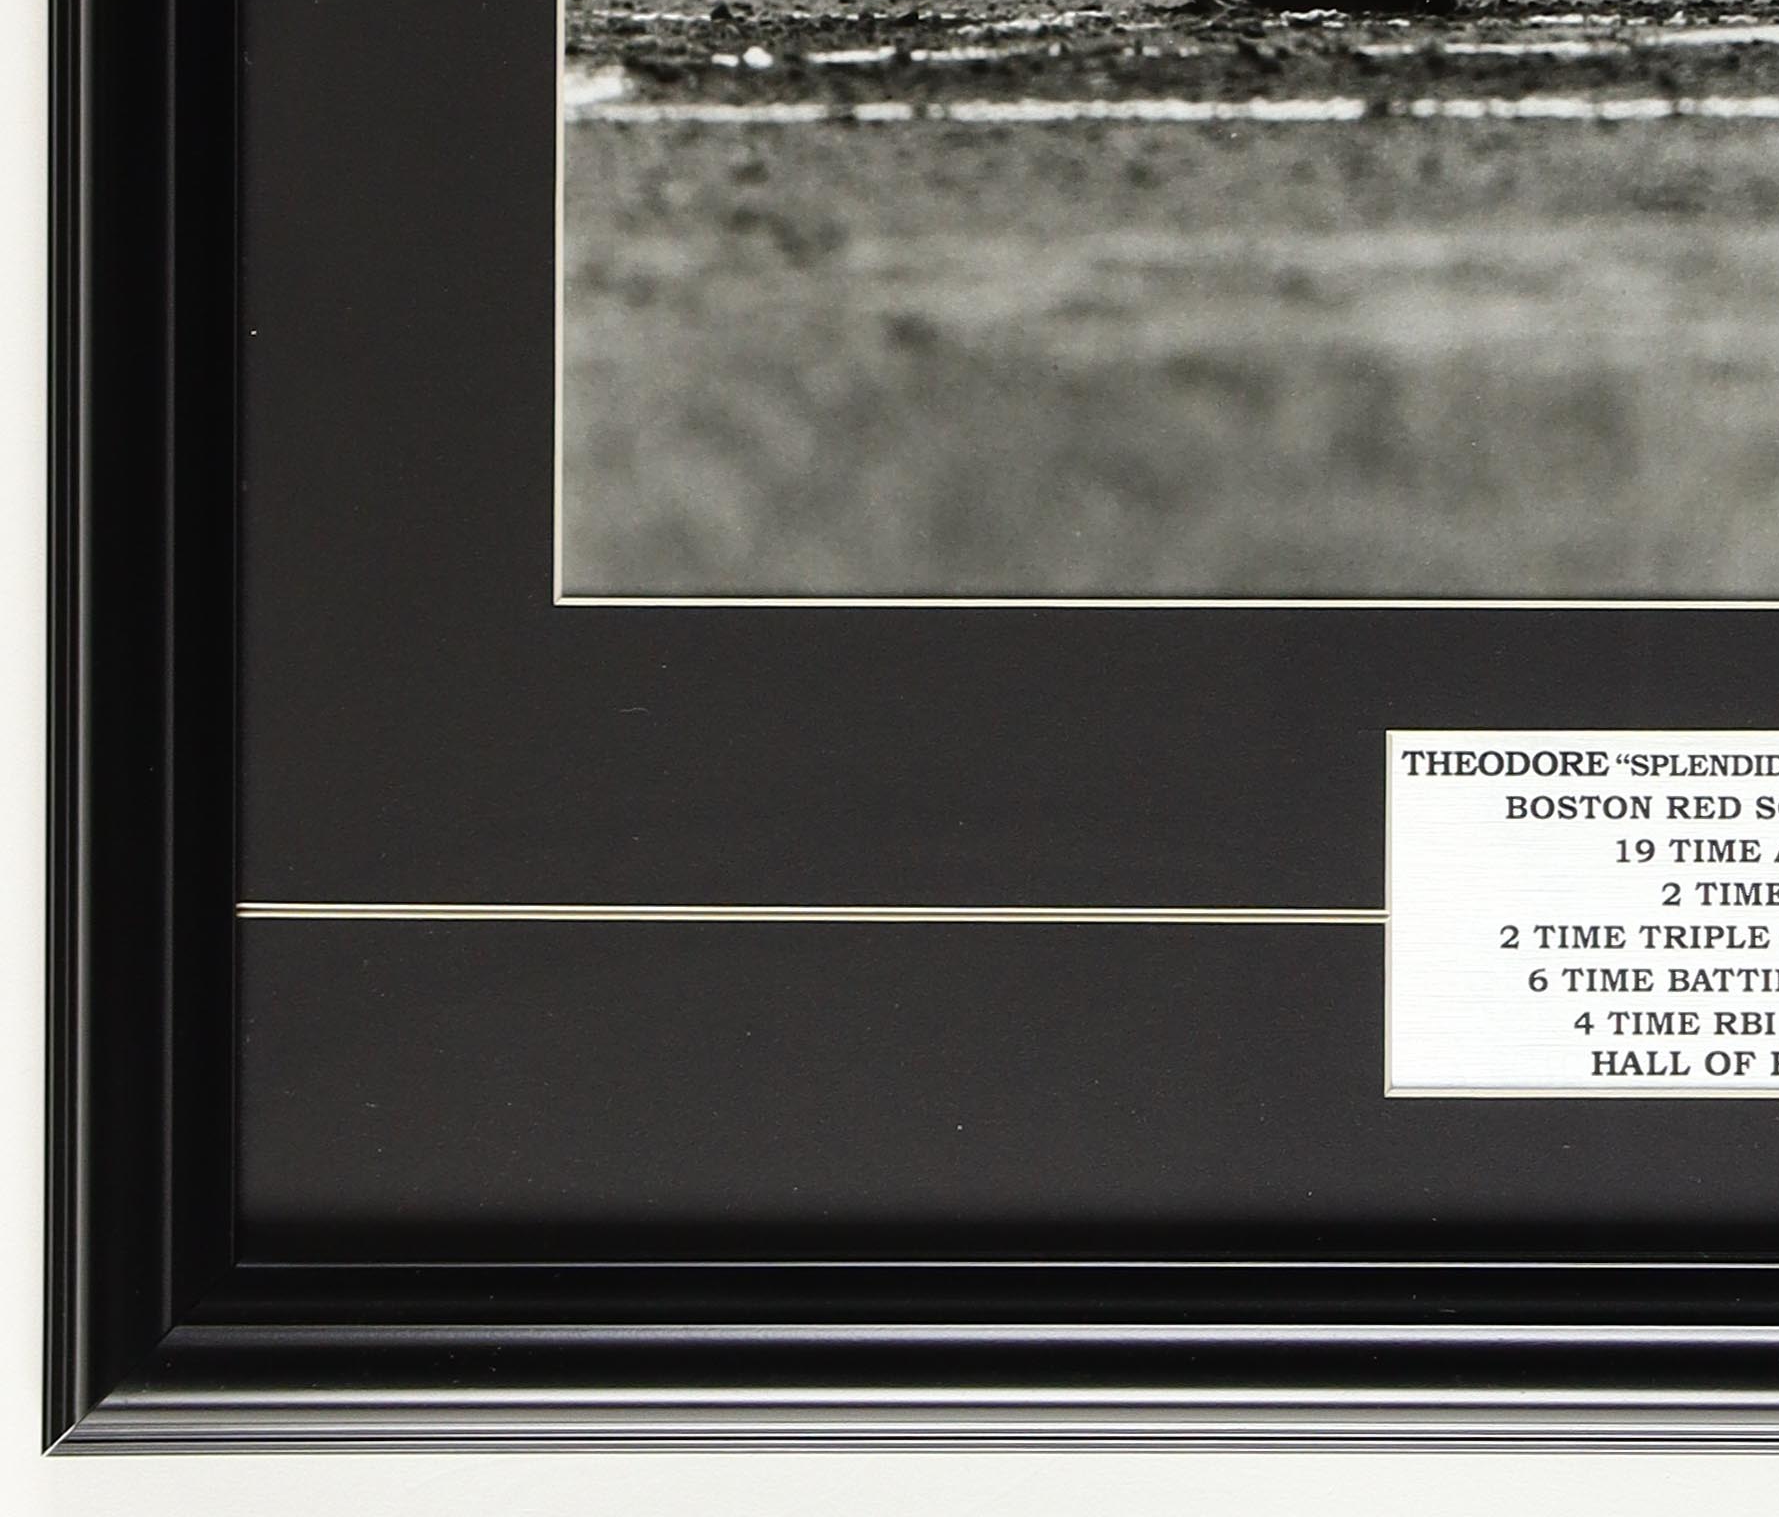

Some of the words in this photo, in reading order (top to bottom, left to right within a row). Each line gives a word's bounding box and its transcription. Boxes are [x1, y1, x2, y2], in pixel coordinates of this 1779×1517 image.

[1401, 750, 1610, 777] THEODORE
[1505, 795, 1653, 820] BOSTON
[1666, 796, 1742, 820] RED
[1617, 839, 1655, 863] 19
[1669, 839, 1762, 863] TIME
[1662, 882, 1681, 906] 2
[1500, 925, 1519, 949] 2
[1534, 925, 1626, 949] TIME
[1640, 925, 1770, 949] TRIPLE
[1528, 968, 1548, 992] 6
[1562, 968, 1654, 992] TIME
[1574, 1011, 1595, 1035] 4
[1608, 1011, 1700, 1036] TIME
[1714, 1011, 1776, 1035] RBI
[1591, 1050, 1691, 1076] HALL
[1704, 1050, 1756, 1076] OF
